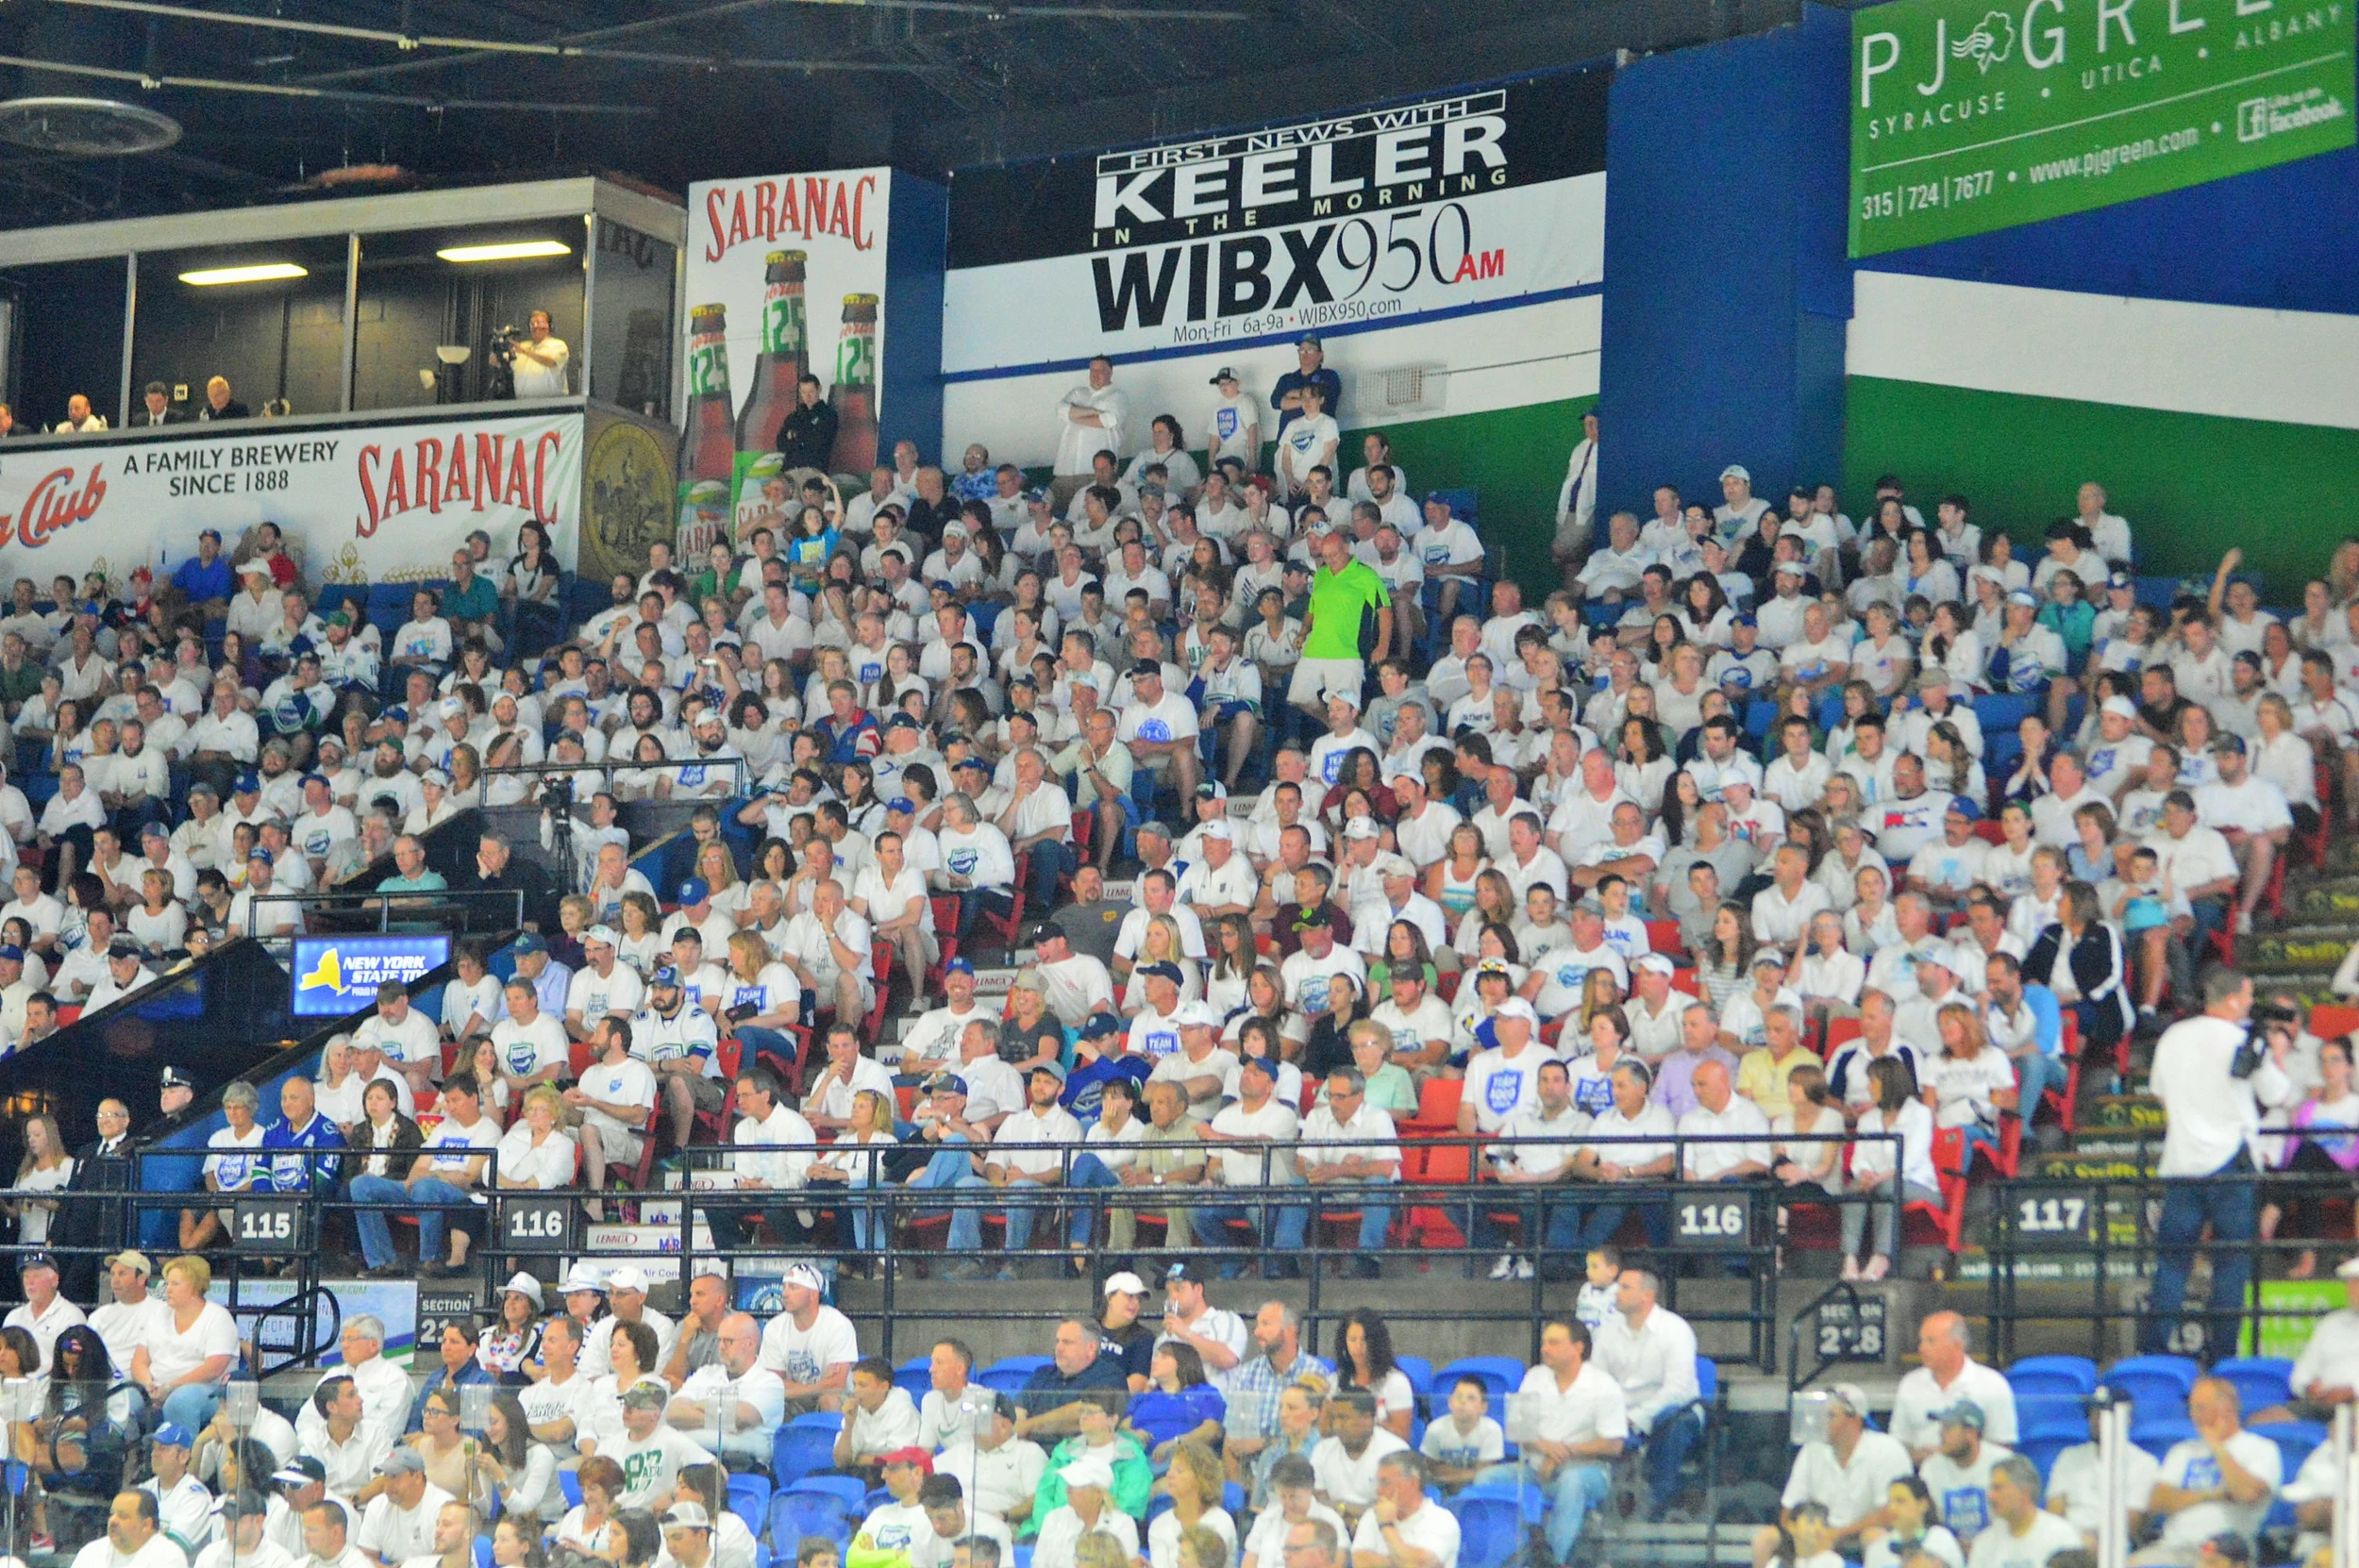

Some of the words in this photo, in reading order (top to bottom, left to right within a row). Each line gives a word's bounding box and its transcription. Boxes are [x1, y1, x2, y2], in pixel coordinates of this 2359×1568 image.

[1861, 19, 1946, 108] PJ
[1868, 92, 2006, 140] SYRACUSE
[2081, 55, 2163, 90] UTICA
[2234, 5, 2342, 51] ALBANY
[1131, 142, 1228, 169] FIRST
[1247, 122, 1354, 152] NEWS
[1373, 101, 1468, 130] WITH
[1094, 114, 1508, 229] KEELER
[2030, 127, 2199, 184] www.pjgreen.com
[706, 175, 876, 263] SARANAC
[1093, 226, 1130, 248] IN
[1184, 209, 1258, 235] THE
[1313, 168, 1507, 217] MORNING
[1173, 321, 1231, 343] Mon-Fri
[1242, 314, 1284, 336] 6a-9a
[1298, 297, 1401, 326] WIBX950.com
[123, 456, 140, 475] A
[146, 448, 225, 473] FAMILY
[231, 441, 340, 467] BREWERY
[169, 473, 236, 496] SINCE
[245, 470, 289, 492] 1888
[356, 430, 560, 539] SARANAC
[18, 462, 108, 548] Club
[343, 955, 381, 970] NEW
[382, 955, 426, 970] YORK
[351, 970, 399, 984] STATE
[242, 1211, 291, 1239] 115
[510, 1210, 562, 1238] 116
[1680, 1204, 1743, 1235] 116
[2019, 1199, 2084, 1231] 117
[421, 1298, 471, 1311] SECTION
[421, 1320, 449, 1343] 21
